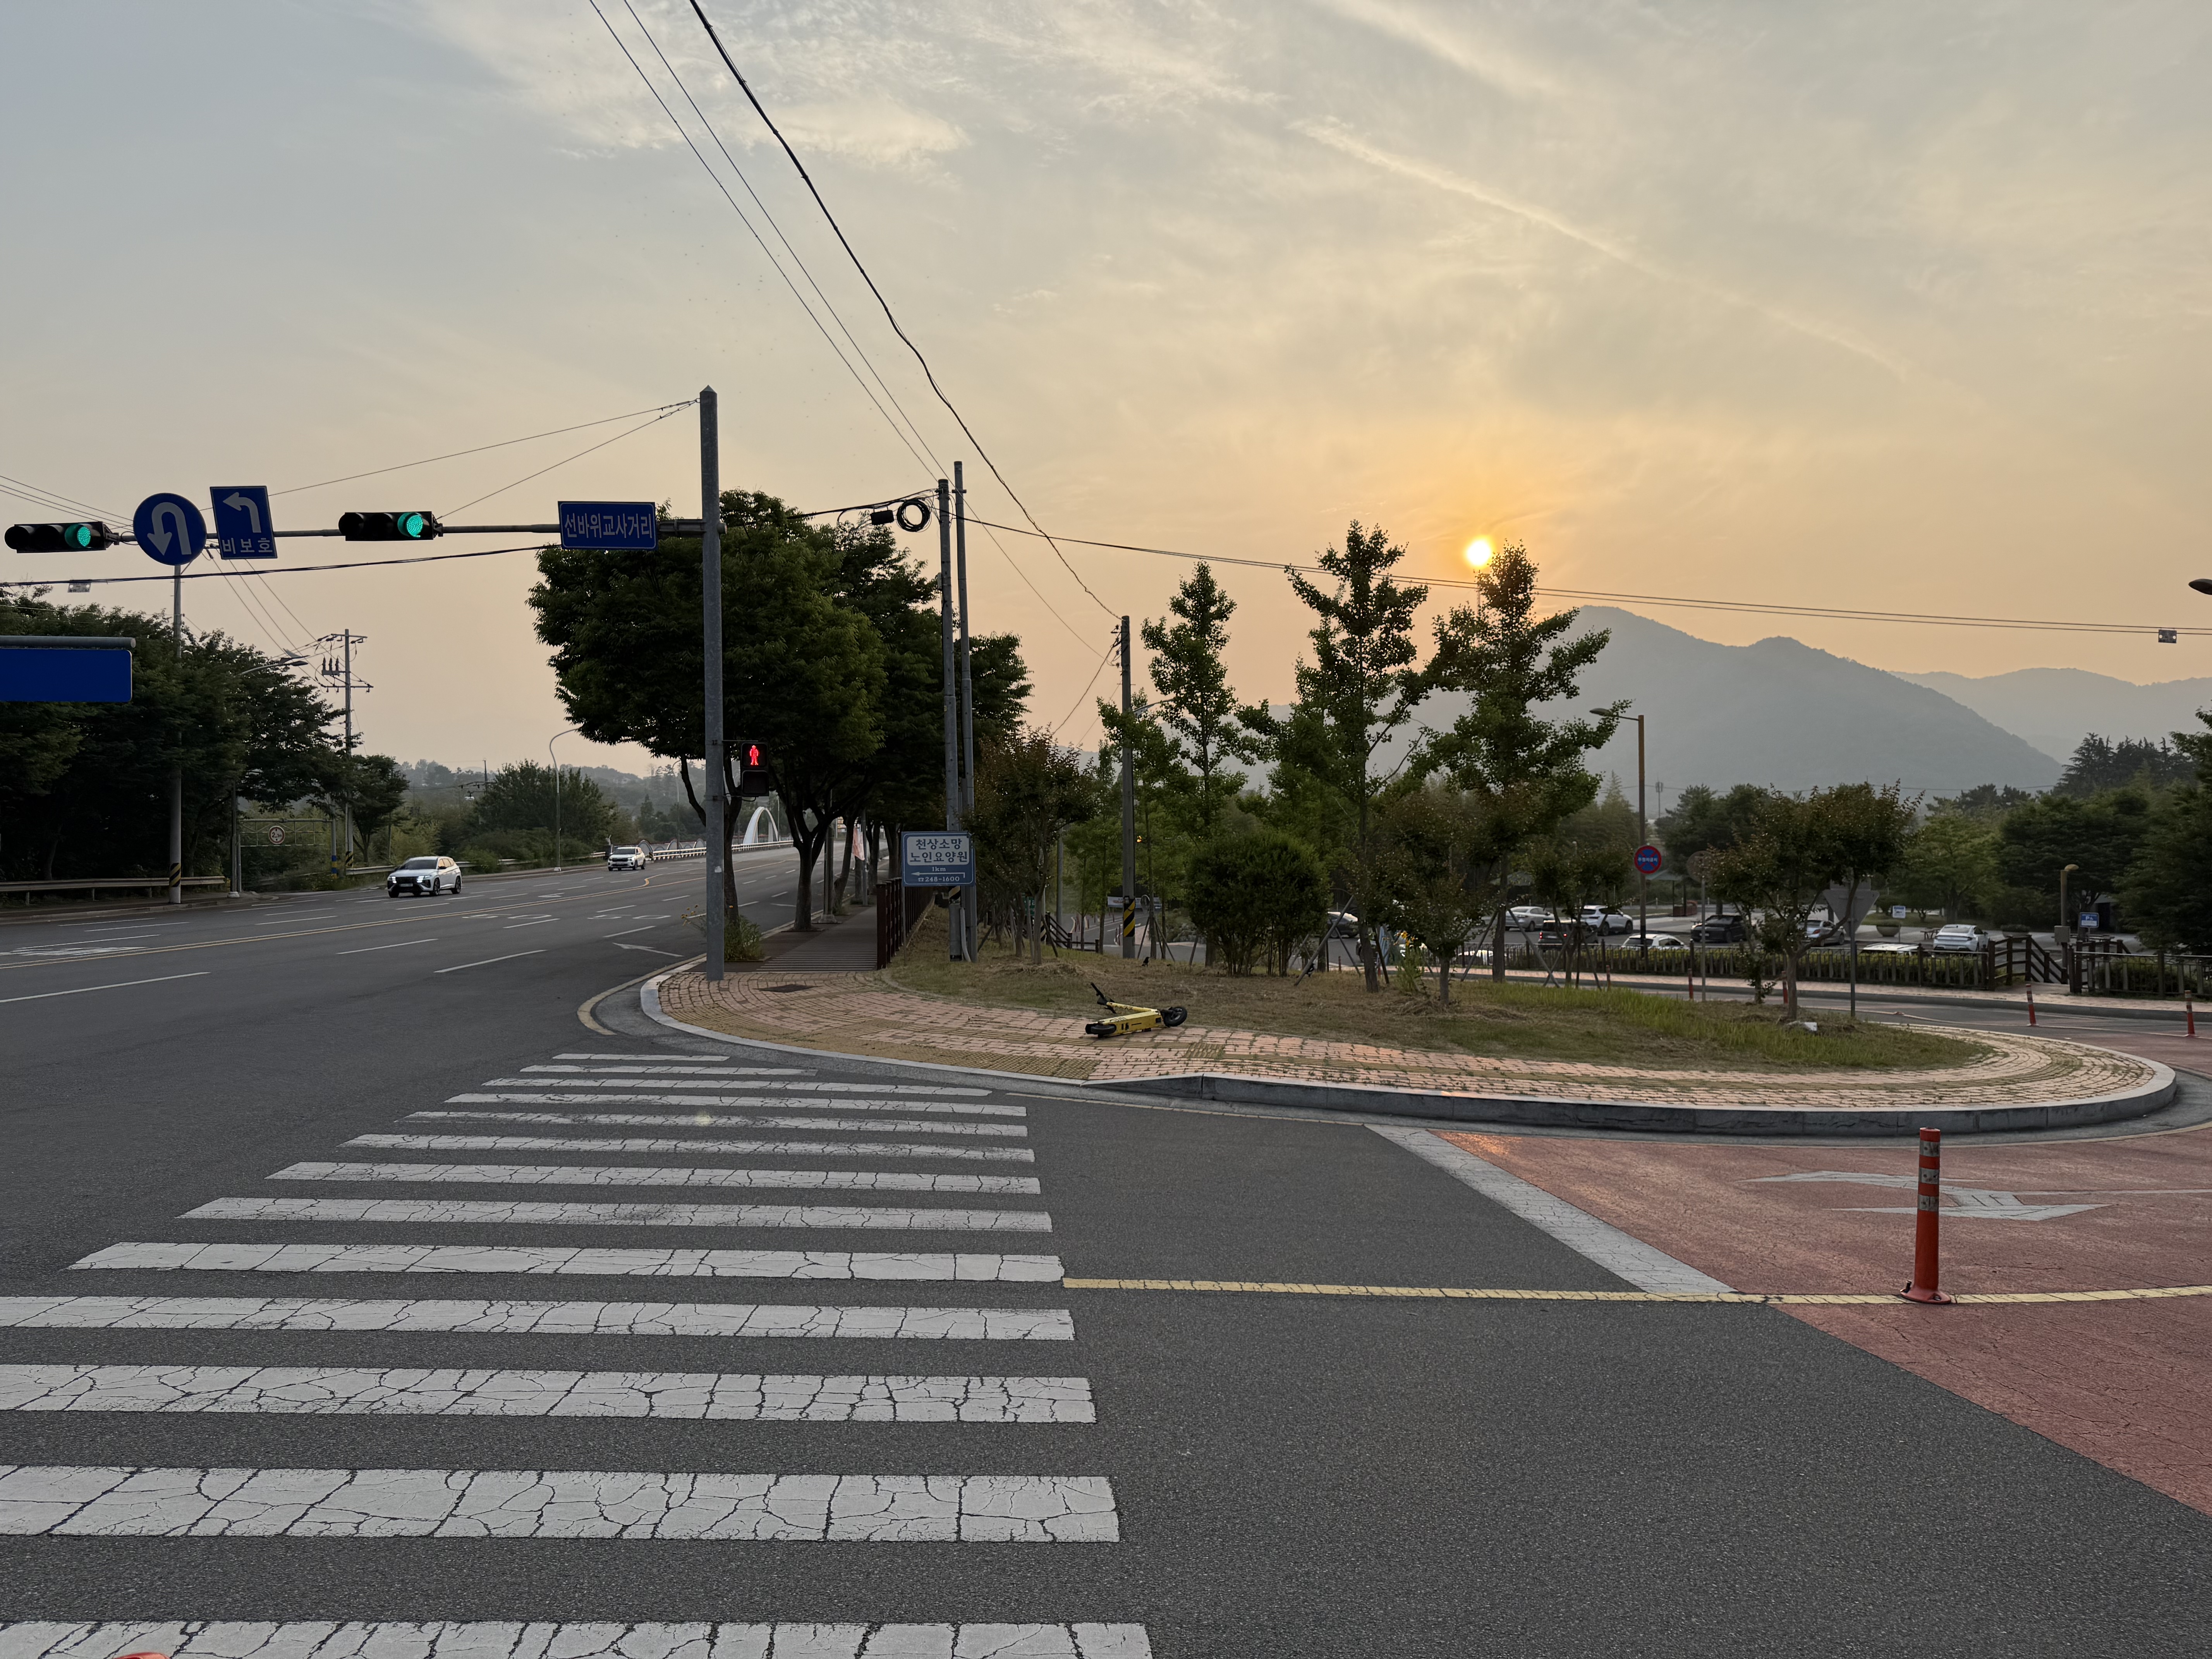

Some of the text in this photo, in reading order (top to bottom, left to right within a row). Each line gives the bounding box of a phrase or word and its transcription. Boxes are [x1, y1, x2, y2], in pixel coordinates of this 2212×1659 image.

[565, 513, 652, 538] 선바위교사거리
[222, 538, 273, 554] 비보호
[916, 838, 962, 850] 천상소망
[910, 851, 967, 863] 노인요양원
